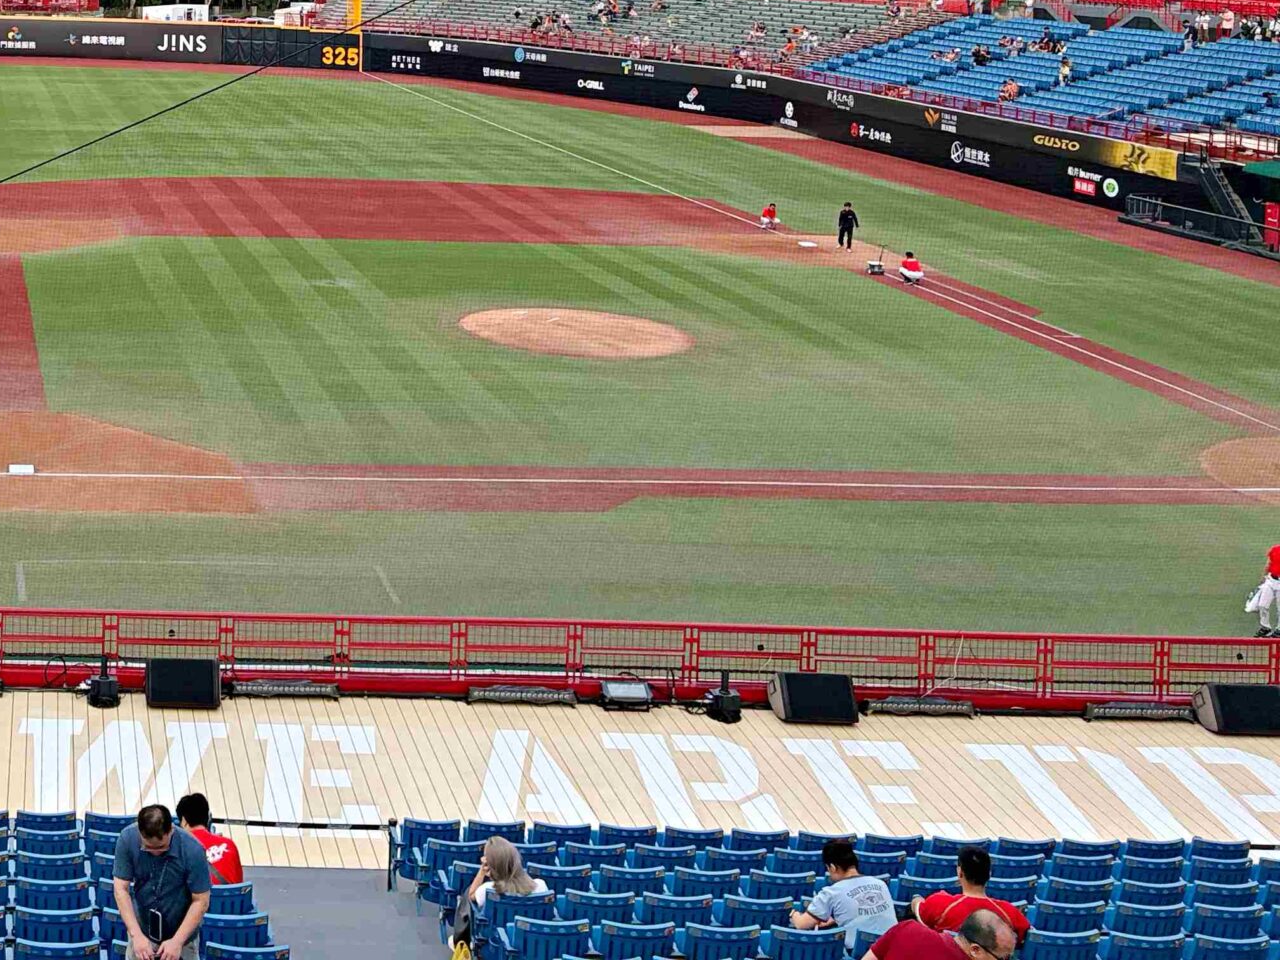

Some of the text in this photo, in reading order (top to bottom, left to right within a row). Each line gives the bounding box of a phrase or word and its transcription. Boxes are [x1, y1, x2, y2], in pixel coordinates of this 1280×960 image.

[321, 46, 359, 66] 325
[634, 63, 655, 74] TAIPEI
[577, 79, 605, 91] O-GRILL
[1033, 134, 1080, 151] GUSTO
[18, 717, 386, 839] WE
